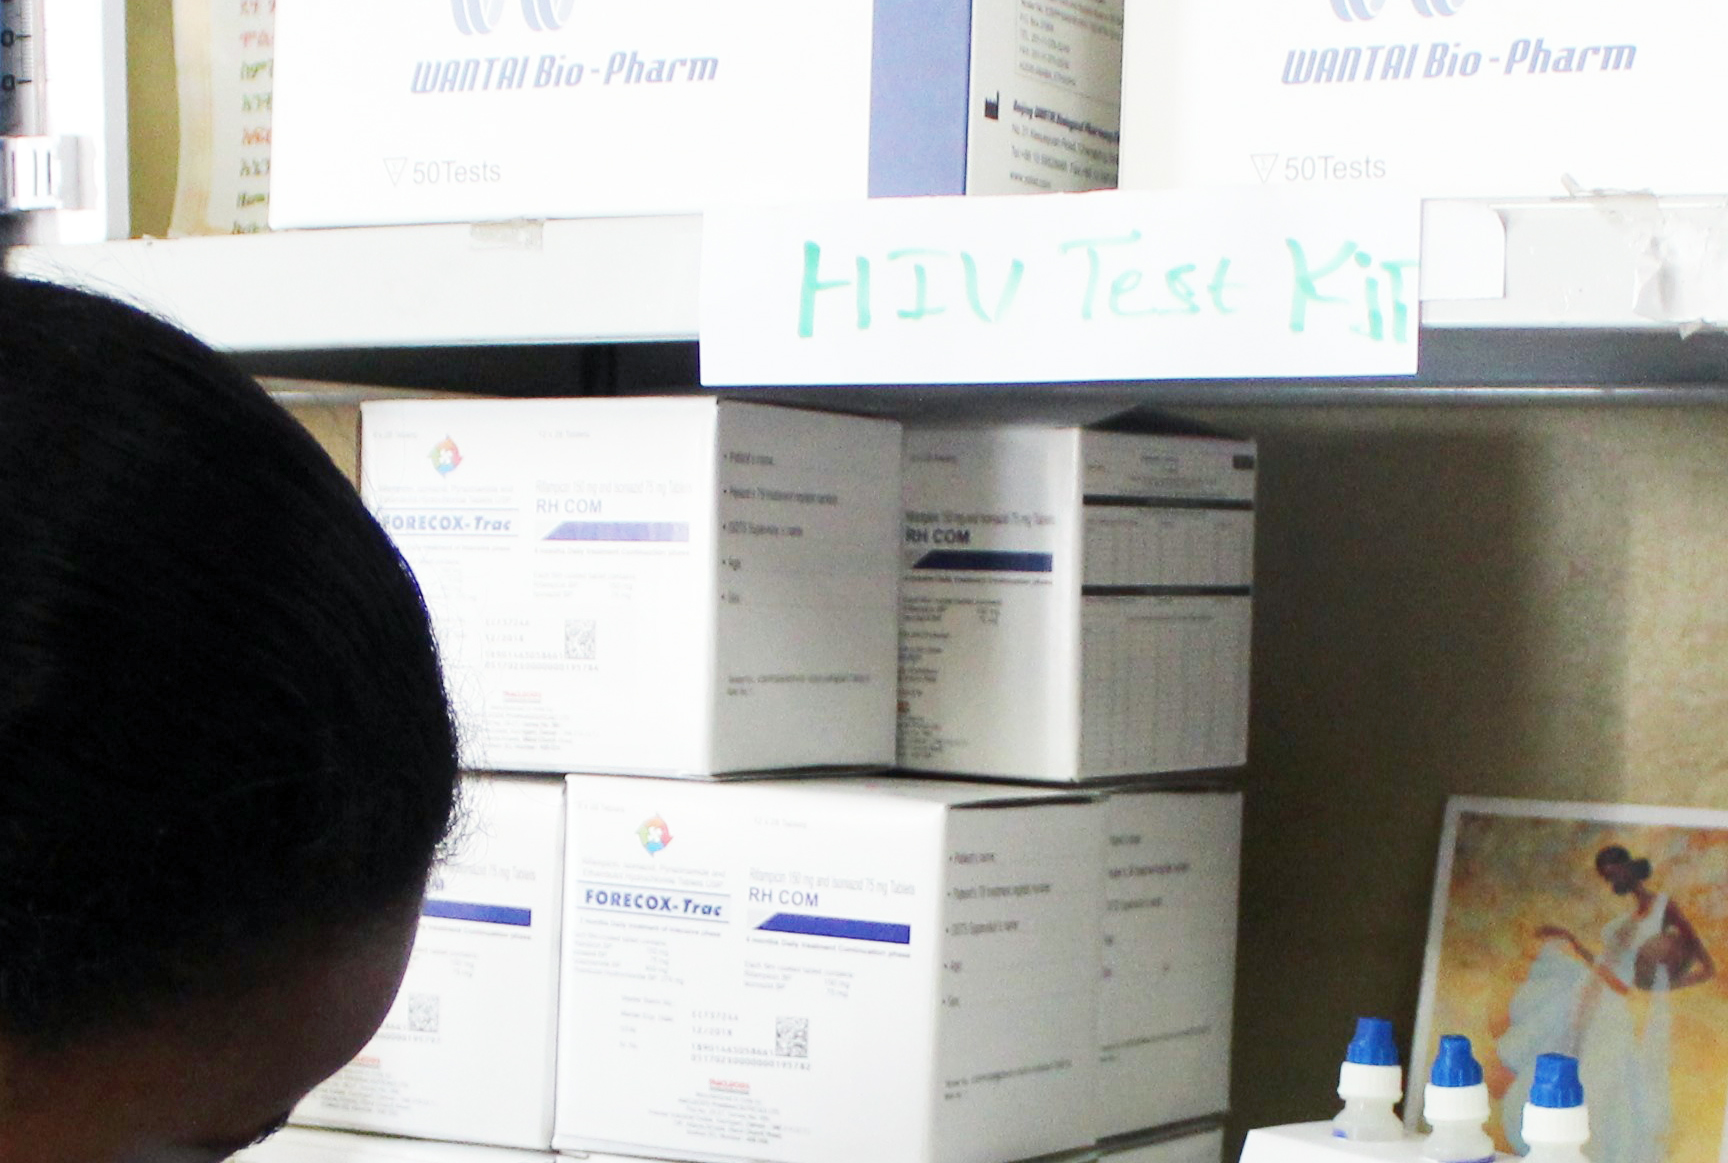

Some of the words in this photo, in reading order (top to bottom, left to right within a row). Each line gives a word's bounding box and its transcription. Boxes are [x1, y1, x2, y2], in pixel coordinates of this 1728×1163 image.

[411, 56, 529, 94] WANTAI
[1282, 43, 1419, 85] WANTAI
[799, 240, 1024, 338] HIV
[1060, 229, 1235, 320] Test
[536, 498, 559, 513] RH
[565, 499, 602, 513] COM
[905, 527, 928, 543] RH
[933, 529, 970, 544] COM
[586, 889, 721, 917] FORECOX-Trac
[749, 887, 773, 902] RH
[779, 890, 819, 907] COM
